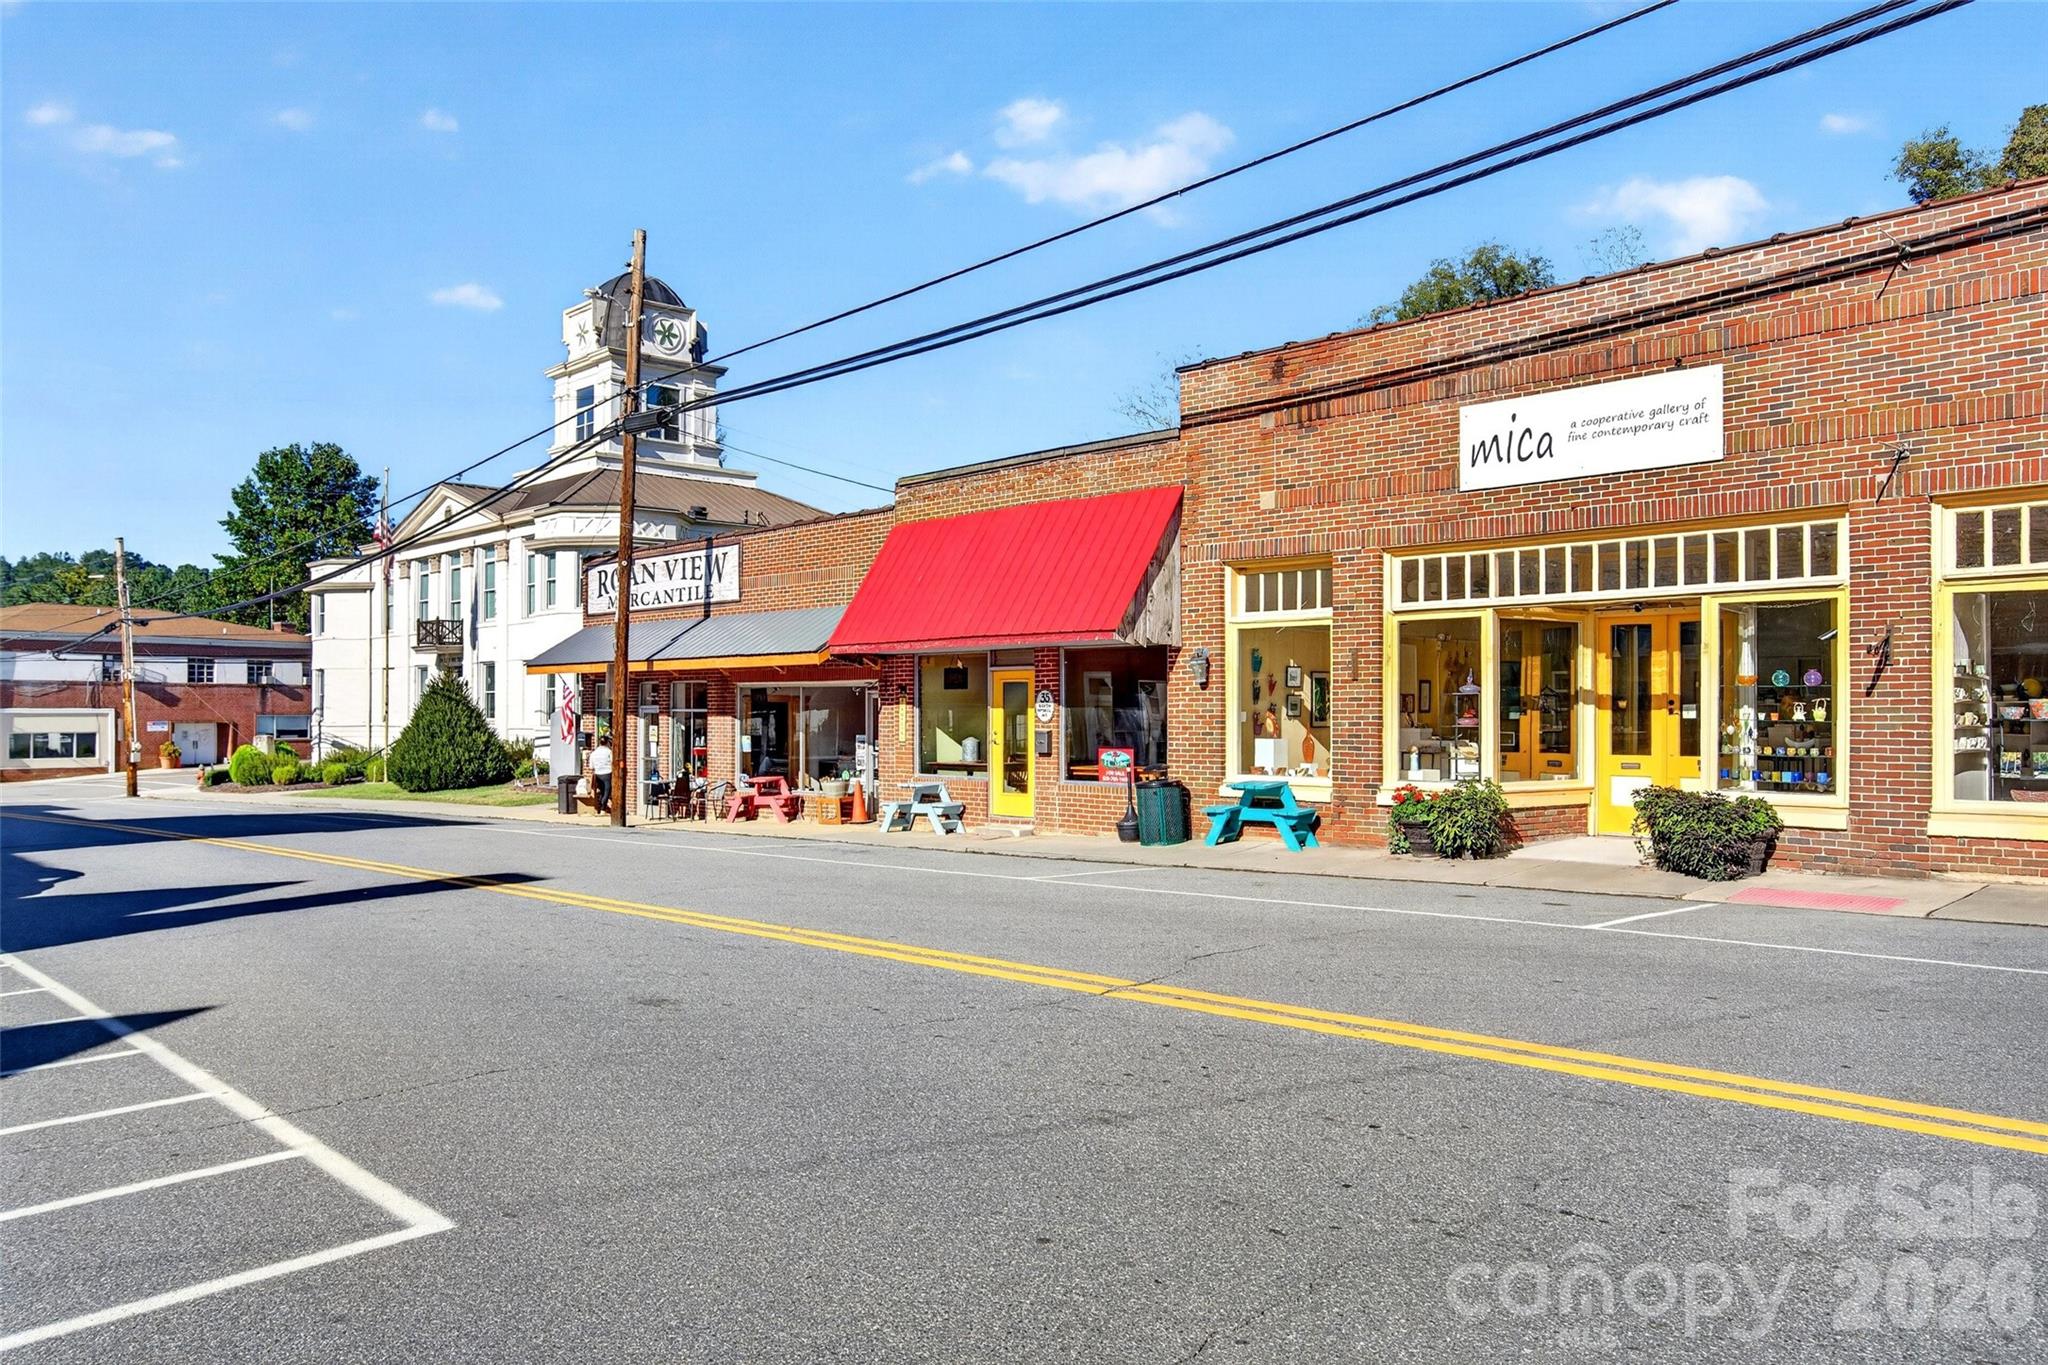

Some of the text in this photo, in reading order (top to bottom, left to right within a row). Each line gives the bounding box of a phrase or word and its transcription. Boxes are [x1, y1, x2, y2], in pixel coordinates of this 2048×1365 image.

[1567, 412, 1710, 443] fine contemporary craft
[1570, 397, 1707, 429] a cooperative gallery of
[1471, 413, 1554, 468] mica
[663, 552, 728, 584] VIEW
[608, 584, 715, 610] MRCANTILE
[1040, 692, 1051, 703] 35
